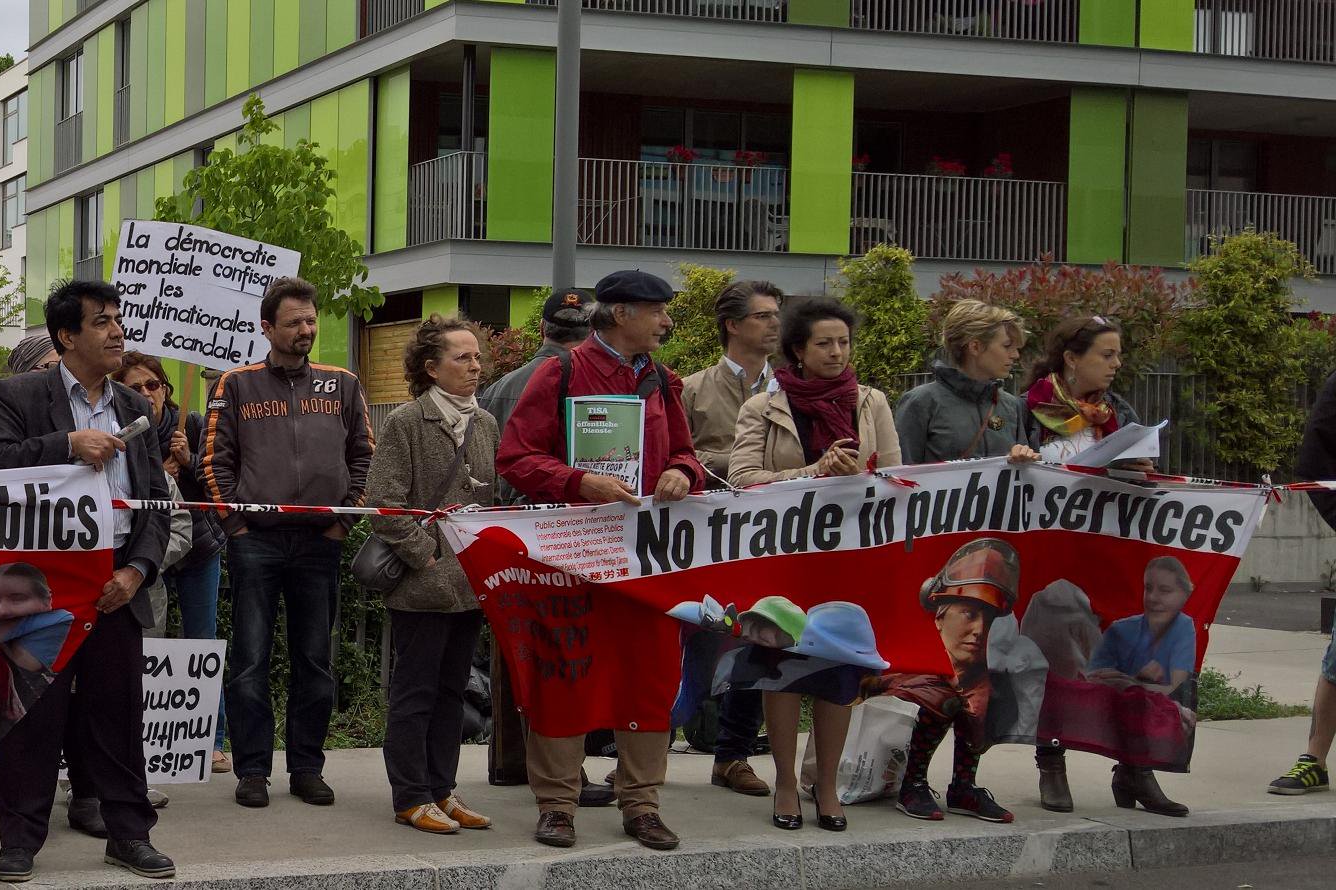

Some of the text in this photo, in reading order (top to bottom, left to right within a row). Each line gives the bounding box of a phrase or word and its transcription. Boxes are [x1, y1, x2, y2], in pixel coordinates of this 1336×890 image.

[127, 222, 277, 267] La démocratie
[118, 253, 203, 276] mondiale
[159, 278, 184, 297] les
[123, 296, 255, 333] multinationales
[122, 320, 149, 342] uel
[313, 379, 337, 393] 76
[240, 400, 288, 422] WARSON
[301, 398, 342, 415] MOTOR
[535, 513, 625, 530] Public Services International
[636, 468, 1244, 576] No trade in public services
[144, 750, 206, 780] Laiss
